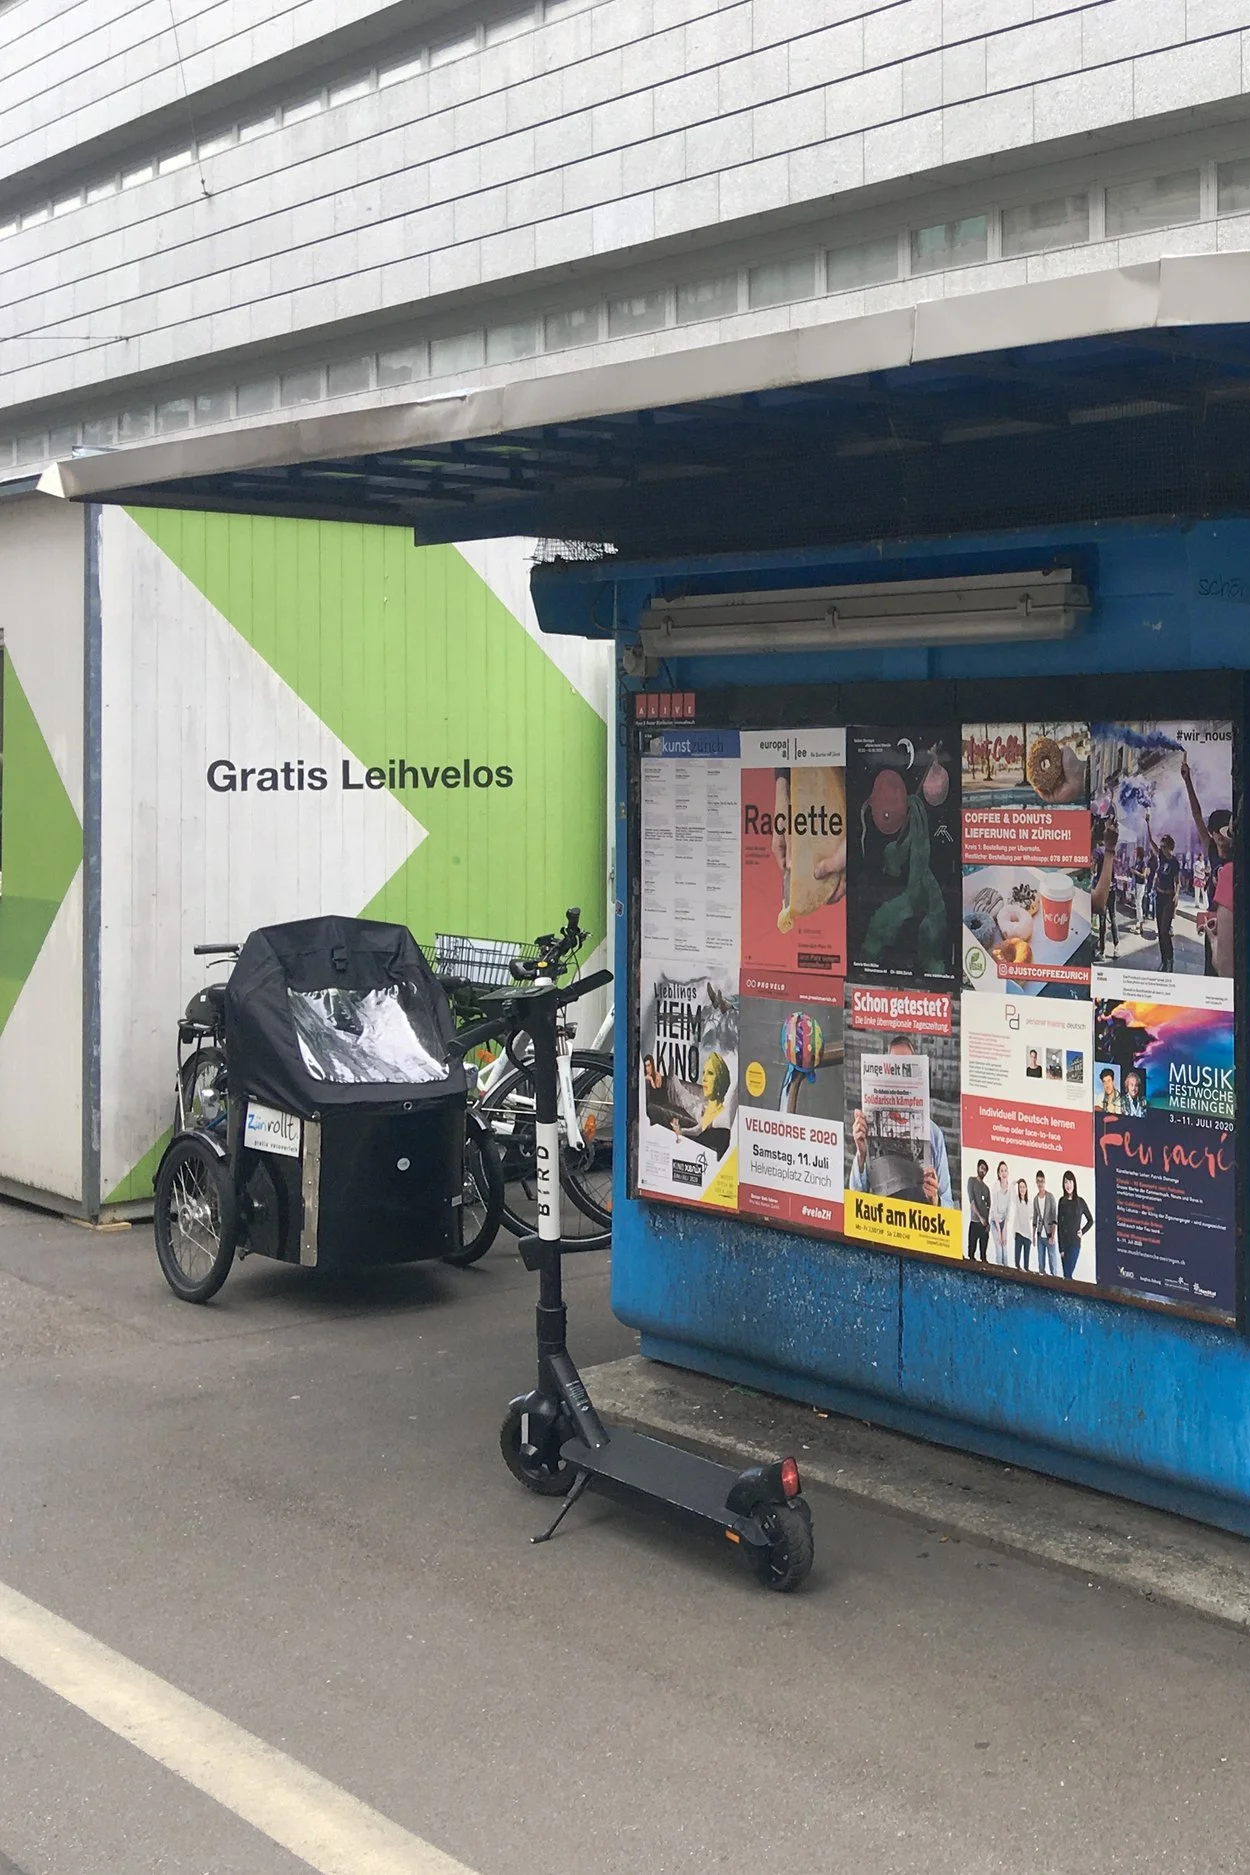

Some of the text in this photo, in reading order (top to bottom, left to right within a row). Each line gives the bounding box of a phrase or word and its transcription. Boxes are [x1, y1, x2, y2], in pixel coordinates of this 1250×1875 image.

[639, 706, 693, 714] ALIVE
[1176, 729, 1233, 744] #wir_nous
[662, 739, 691, 753] kunst
[759, 740, 788, 752] europa
[206, 758, 514, 793] Gratis Leihvelos
[744, 804, 843, 836] Raclette
[964, 812, 1053, 825] COFFEE & DONUTS
[964, 827, 1072, 841] LIEFERUNG IN ZÜRICH!
[983, 844, 1008, 852] Bestellung
[988, 854, 1013, 862] Bestellung
[1008, 966, 1089, 981] @JUSTCOFFEEZURICH
[653, 981, 698, 1001] Lieblings
[853, 991, 950, 1018] Schon getestet?
[656, 1000, 702, 1042] HEIM
[854, 1015, 864, 1025] Die
[864, 1016, 876, 1026] linke
[876, 1017, 912, 1029] überregionale
[1066, 1022, 1087, 1030] deutsch
[656, 1039, 700, 1084] KINO
[863, 1060, 901, 1077] junge Welt
[1169, 1062, 1234, 1091] MUSIK
[864, 1094, 924, 1108] Solidarisch kämpfen
[1169, 1083, 1234, 1103] FESTWOCHE
[1169, 1095, 1234, 1116] MEIRINGEN
[979, 1105, 1076, 1130] Individuell Deutsch lernen
[1195, 1118, 1213, 1129] JULI
[1214, 1120, 1234, 1132] 2020
[745, 1117, 838, 1146] VELOBÖRSE 2020
[992, 1124, 1062, 1141] online oder face-to-face
[752, 1144, 829, 1170] Samstag, 11. Juli
[537, 1145, 551, 1217] BIRD
[750, 1160, 832, 1188] Helvetiaplatz Zürich
[801, 1205, 832, 1221] #veloZH
[855, 1198, 951, 1237] Kauf am Kiosk.
